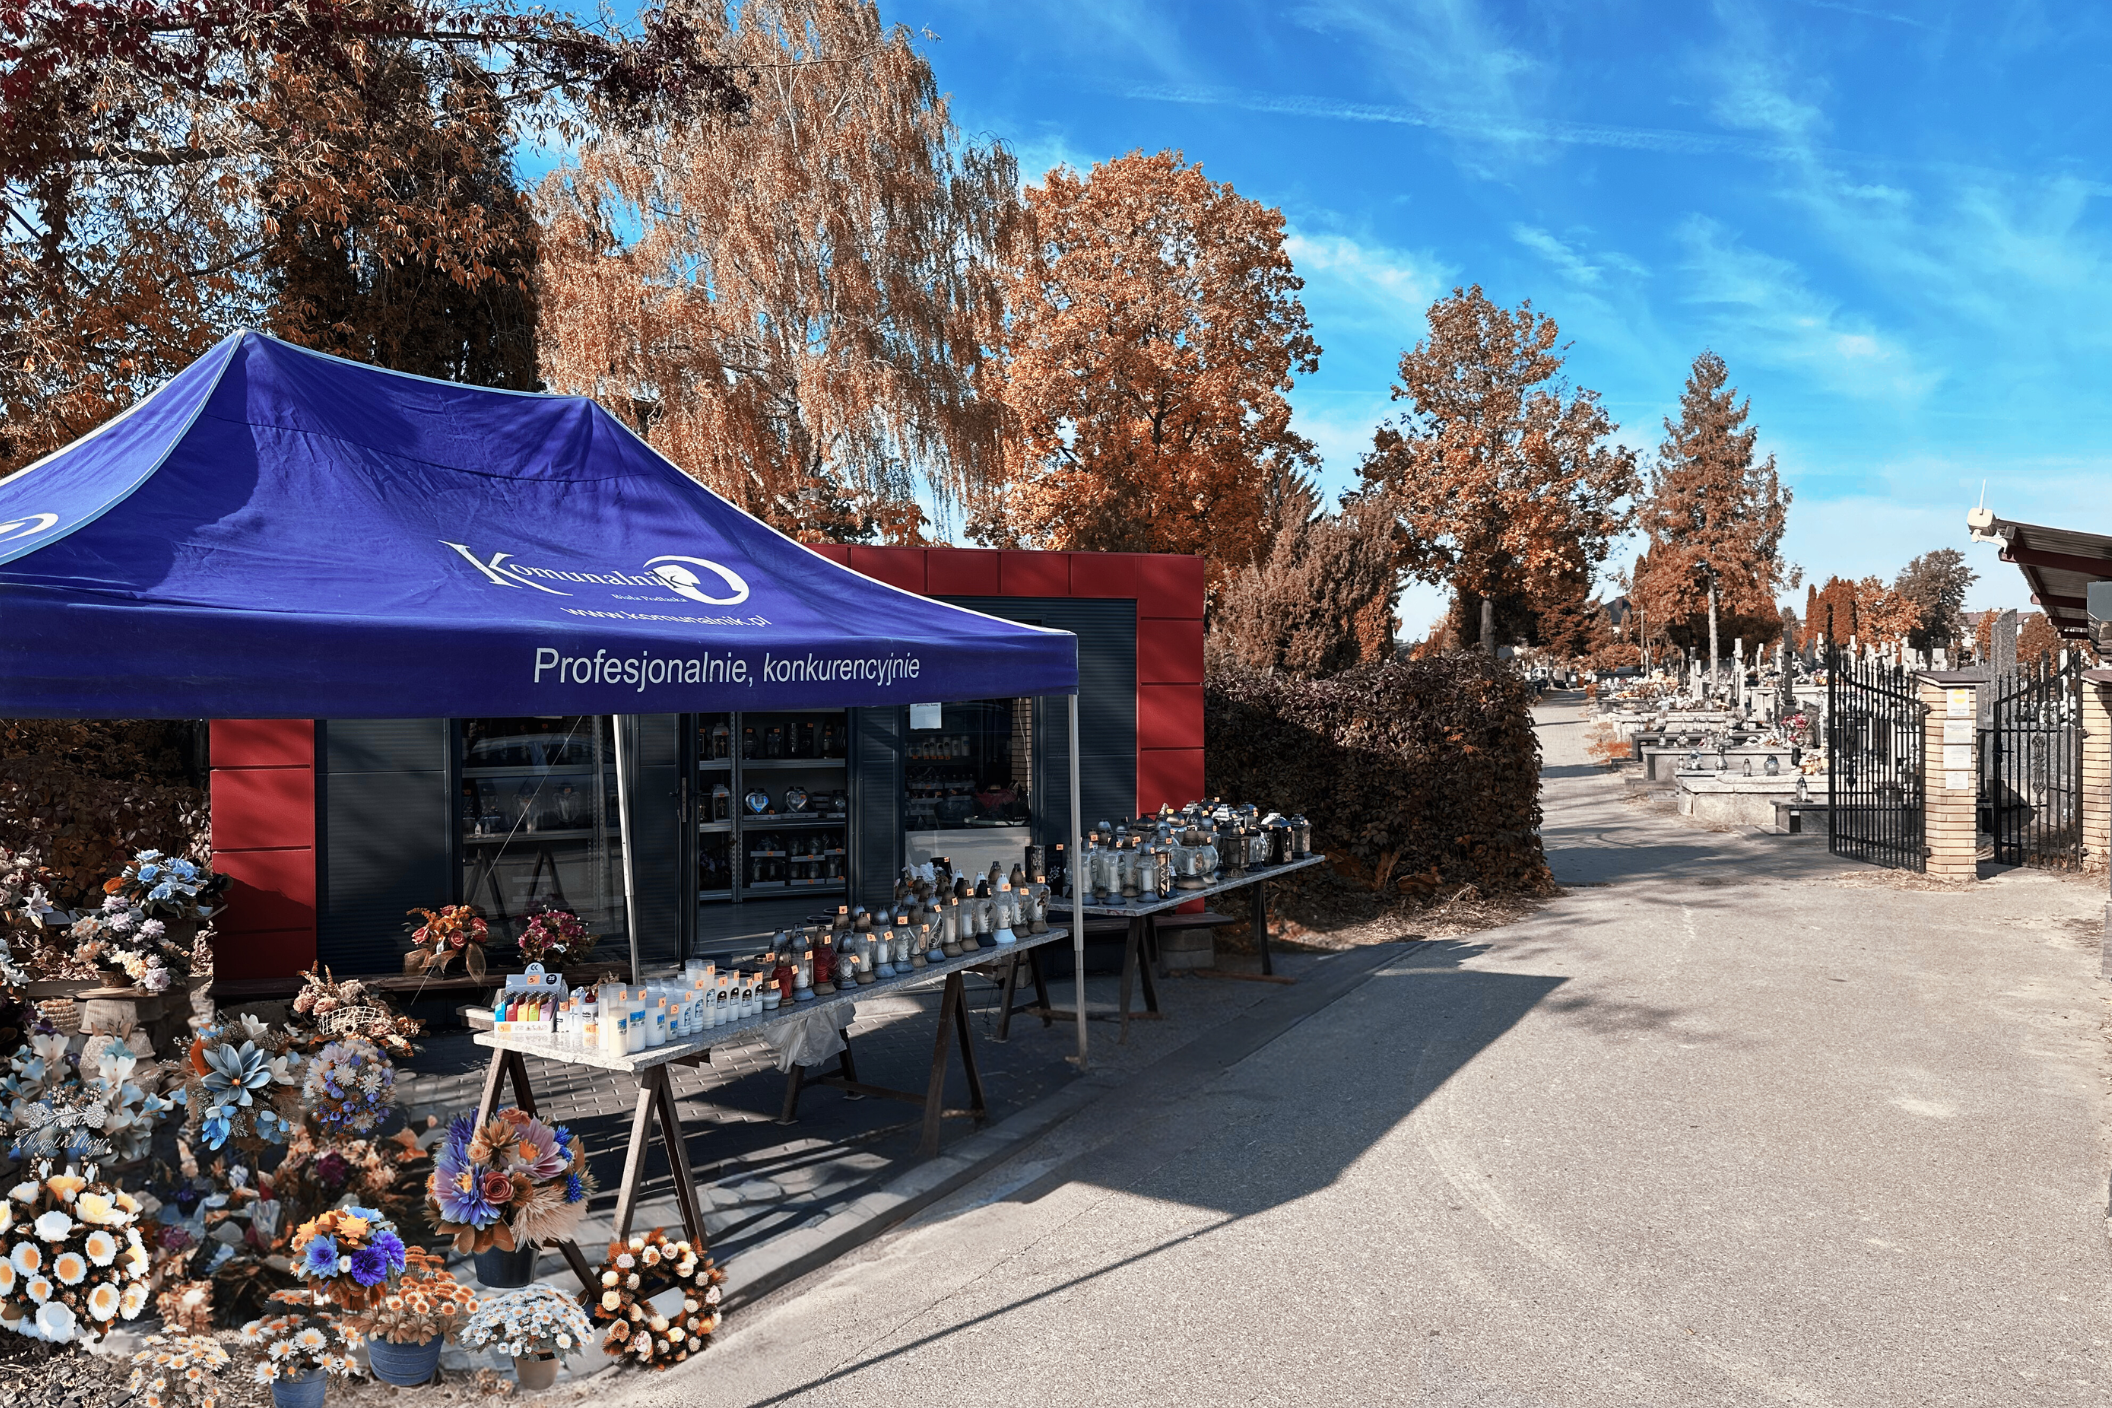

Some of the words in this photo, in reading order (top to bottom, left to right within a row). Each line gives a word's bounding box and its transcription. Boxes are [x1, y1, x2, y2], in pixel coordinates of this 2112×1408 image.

[560, 607, 772, 628] www.komunalnik.pl
[534, 647, 754, 693] Profesjonalnie,
[763, 652, 920, 688] konkurencyjnie
